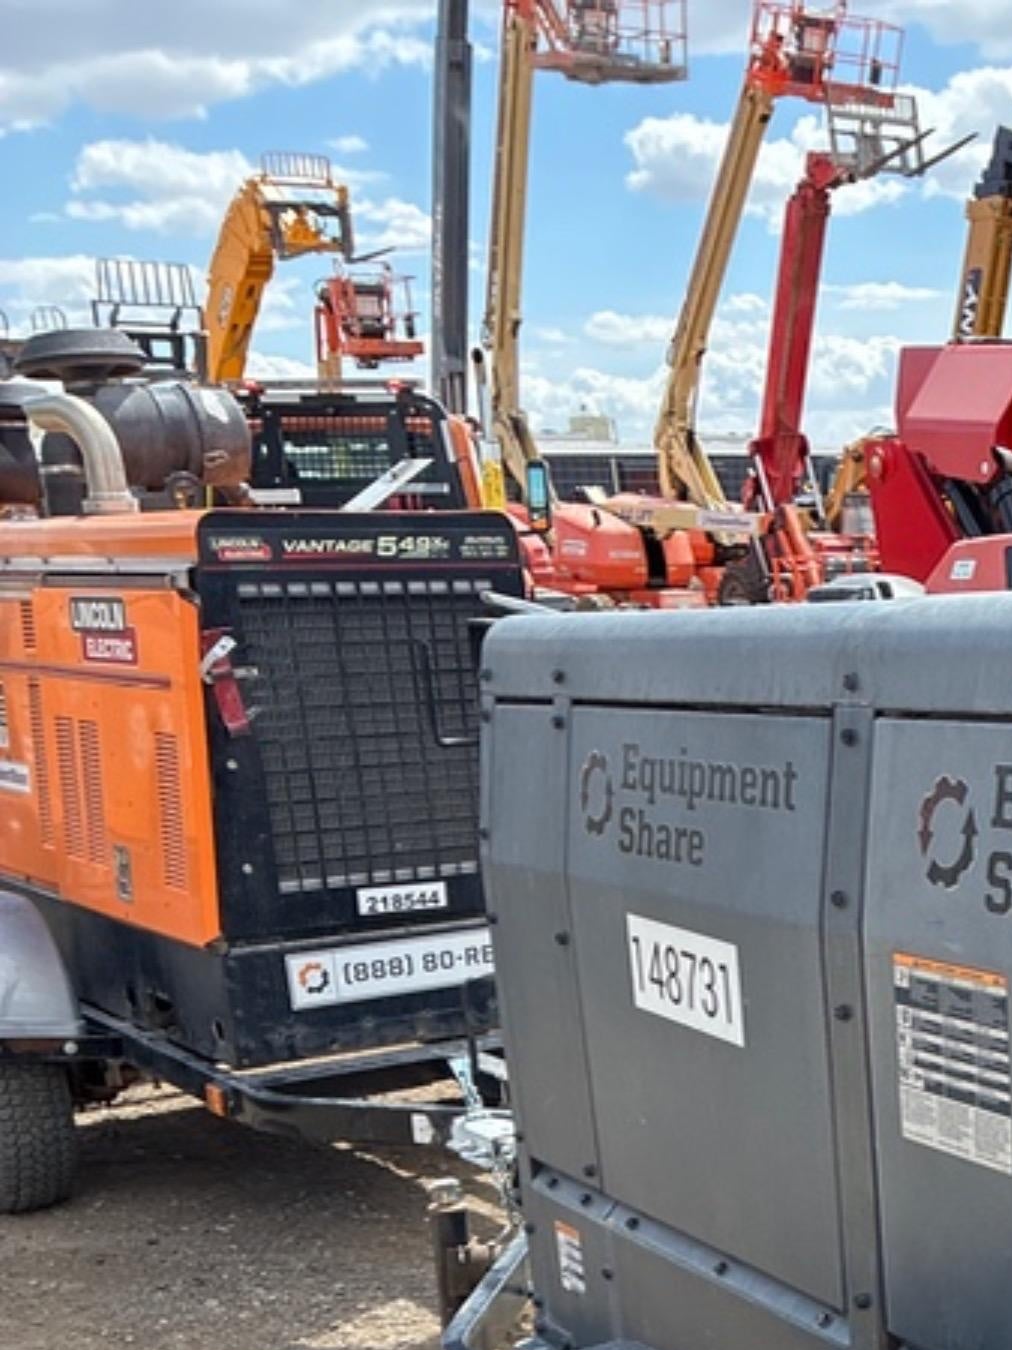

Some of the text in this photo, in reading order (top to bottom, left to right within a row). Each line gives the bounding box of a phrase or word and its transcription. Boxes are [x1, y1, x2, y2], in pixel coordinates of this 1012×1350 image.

[282, 539, 376, 554] VANTAGE
[72, 602, 125, 629] LINCOLN
[622, 743, 798, 812] Equipment
[618, 805, 705, 866] Share
[365, 890, 441, 913] 218544
[343, 954, 415, 985] (888)
[630, 934, 736, 1025] 148731
